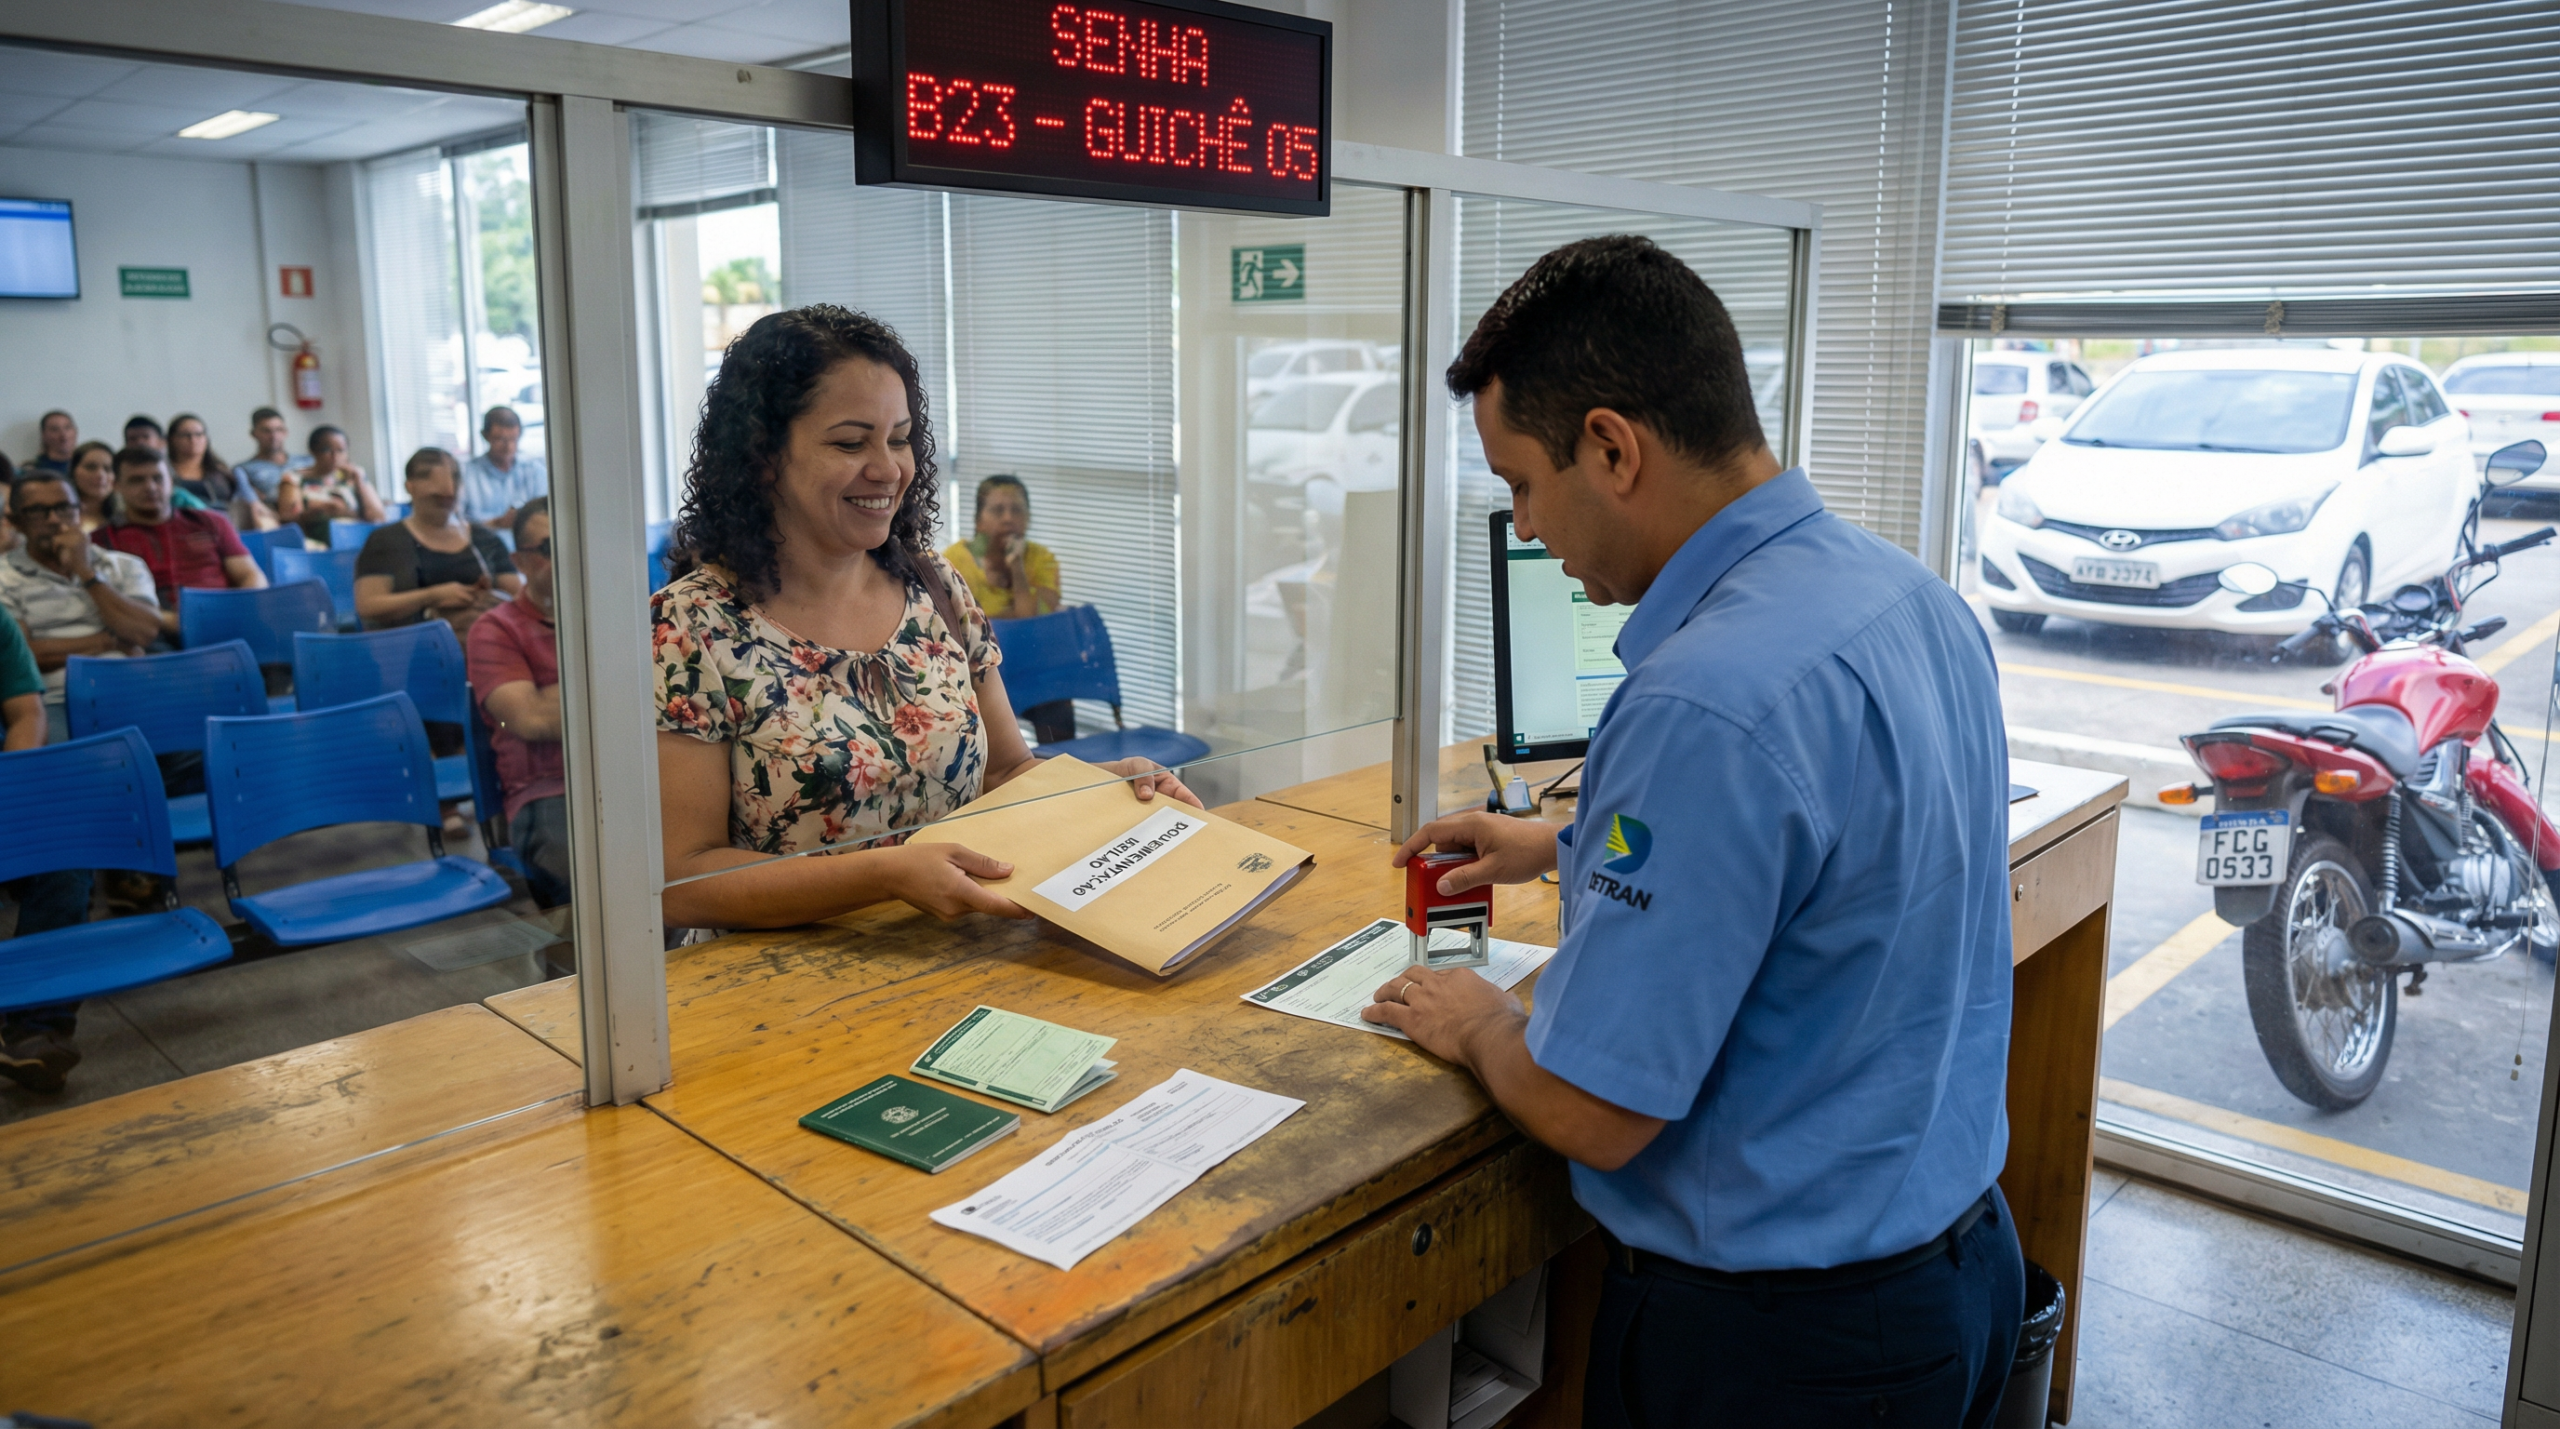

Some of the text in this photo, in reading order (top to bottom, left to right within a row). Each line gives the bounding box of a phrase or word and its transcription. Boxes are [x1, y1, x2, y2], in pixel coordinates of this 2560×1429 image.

[1051, 4, 1209, 87] SENHA
[907, 72, 1016, 149] B23
[1085, 97, 1253, 174] GUICHÊ
[1266, 122, 1318, 181] 05
[2206, 855, 2273, 879] 0533
[2214, 829, 2268, 854] FCG
